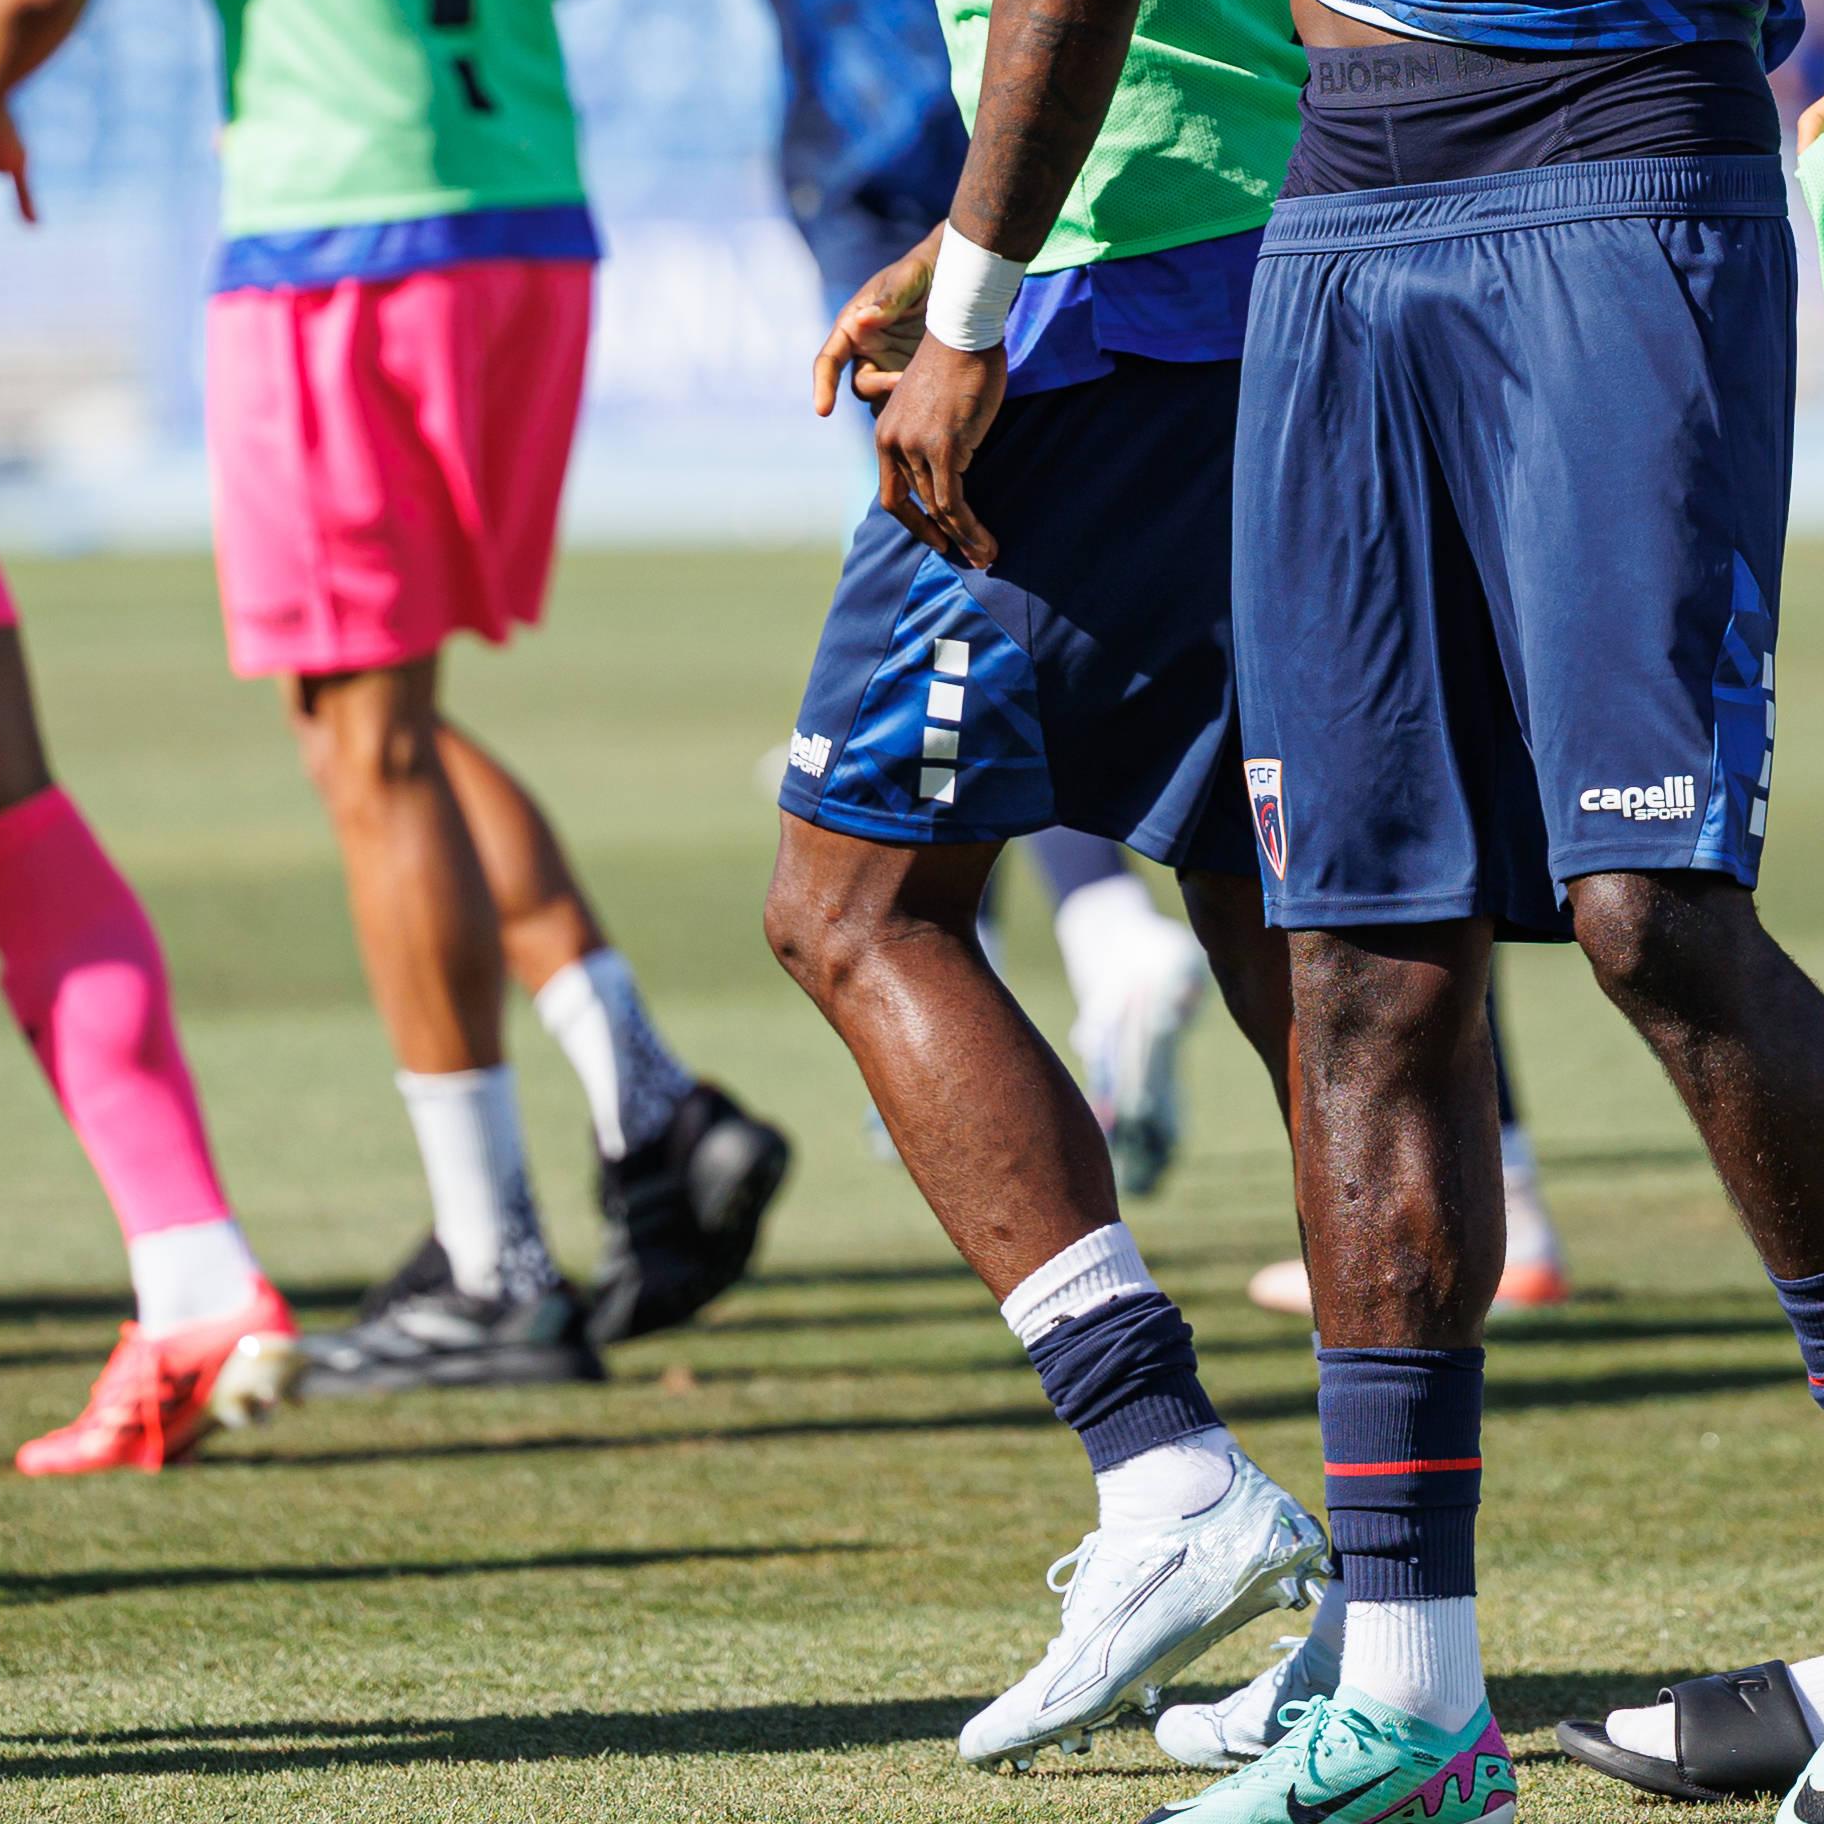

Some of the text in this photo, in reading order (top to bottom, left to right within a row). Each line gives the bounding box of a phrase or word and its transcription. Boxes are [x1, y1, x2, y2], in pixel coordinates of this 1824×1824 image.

[1318, 50, 1440, 95] BJÖRN
[1249, 767, 1277, 785] FCF
[1579, 774, 1695, 818] capelli
[1633, 806, 1696, 821] SPORT
